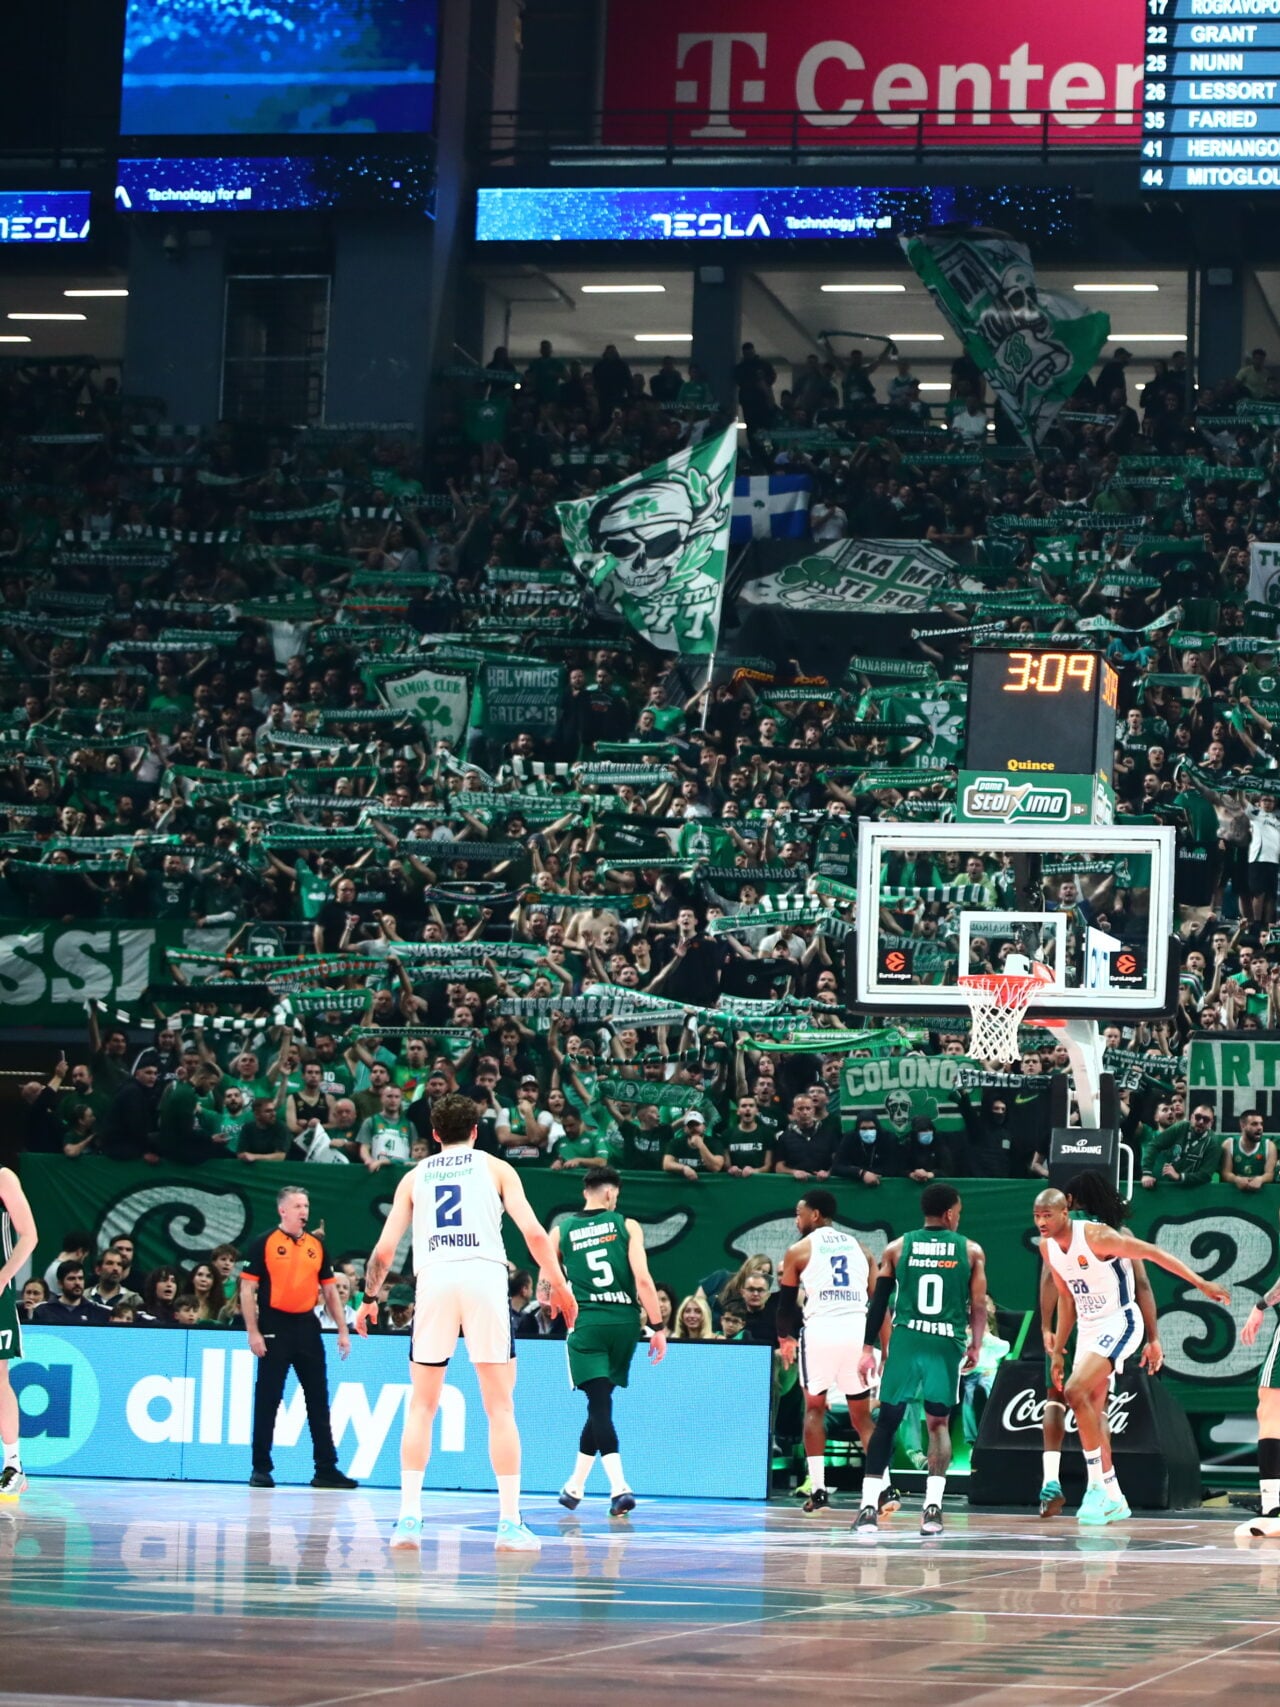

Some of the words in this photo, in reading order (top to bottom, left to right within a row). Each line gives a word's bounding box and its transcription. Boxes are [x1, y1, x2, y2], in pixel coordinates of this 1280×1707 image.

[1147, 26, 1167, 44] 22
[1190, 26, 1258, 43] GRANT
[1146, 55, 1167, 72] 25
[1189, 54, 1244, 71] NUNN
[675, 32, 767, 138] T
[796, 41, 1144, 128] Center
[1145, 83, 1166, 101] 26
[1189, 82, 1277, 99] LESSORT
[1144, 112, 1165, 129] 35
[1188, 111, 1258, 128] FARIED
[1142, 140, 1163, 157] 41
[1142, 169, 1163, 186] 44
[147, 187, 216, 203] Technology
[218, 187, 236, 202] for
[237, 187, 252, 201] all
[651, 213, 771, 237] TESLA
[785, 215, 855, 231] Technology
[857, 215, 875, 230] for
[876, 215, 891, 229] all
[1003, 652, 1096, 692] 3:09
[393, 679, 431, 699] SAMOS
[489, 706, 525, 723] GATE
[543, 706, 558, 723] 13
[1007, 758, 1055, 771] Quince
[1060, 1143, 1103, 1156] SPALDING
[427, 1153, 473, 1169] HAZER
[434, 1184, 463, 1229] 2
[572, 1234, 618, 1252] instacar
[586, 1248, 614, 1288] 5
[830, 1255, 850, 1287] 3
[908, 1257, 958, 1269] instacar
[917, 1274, 944, 1315] 0
